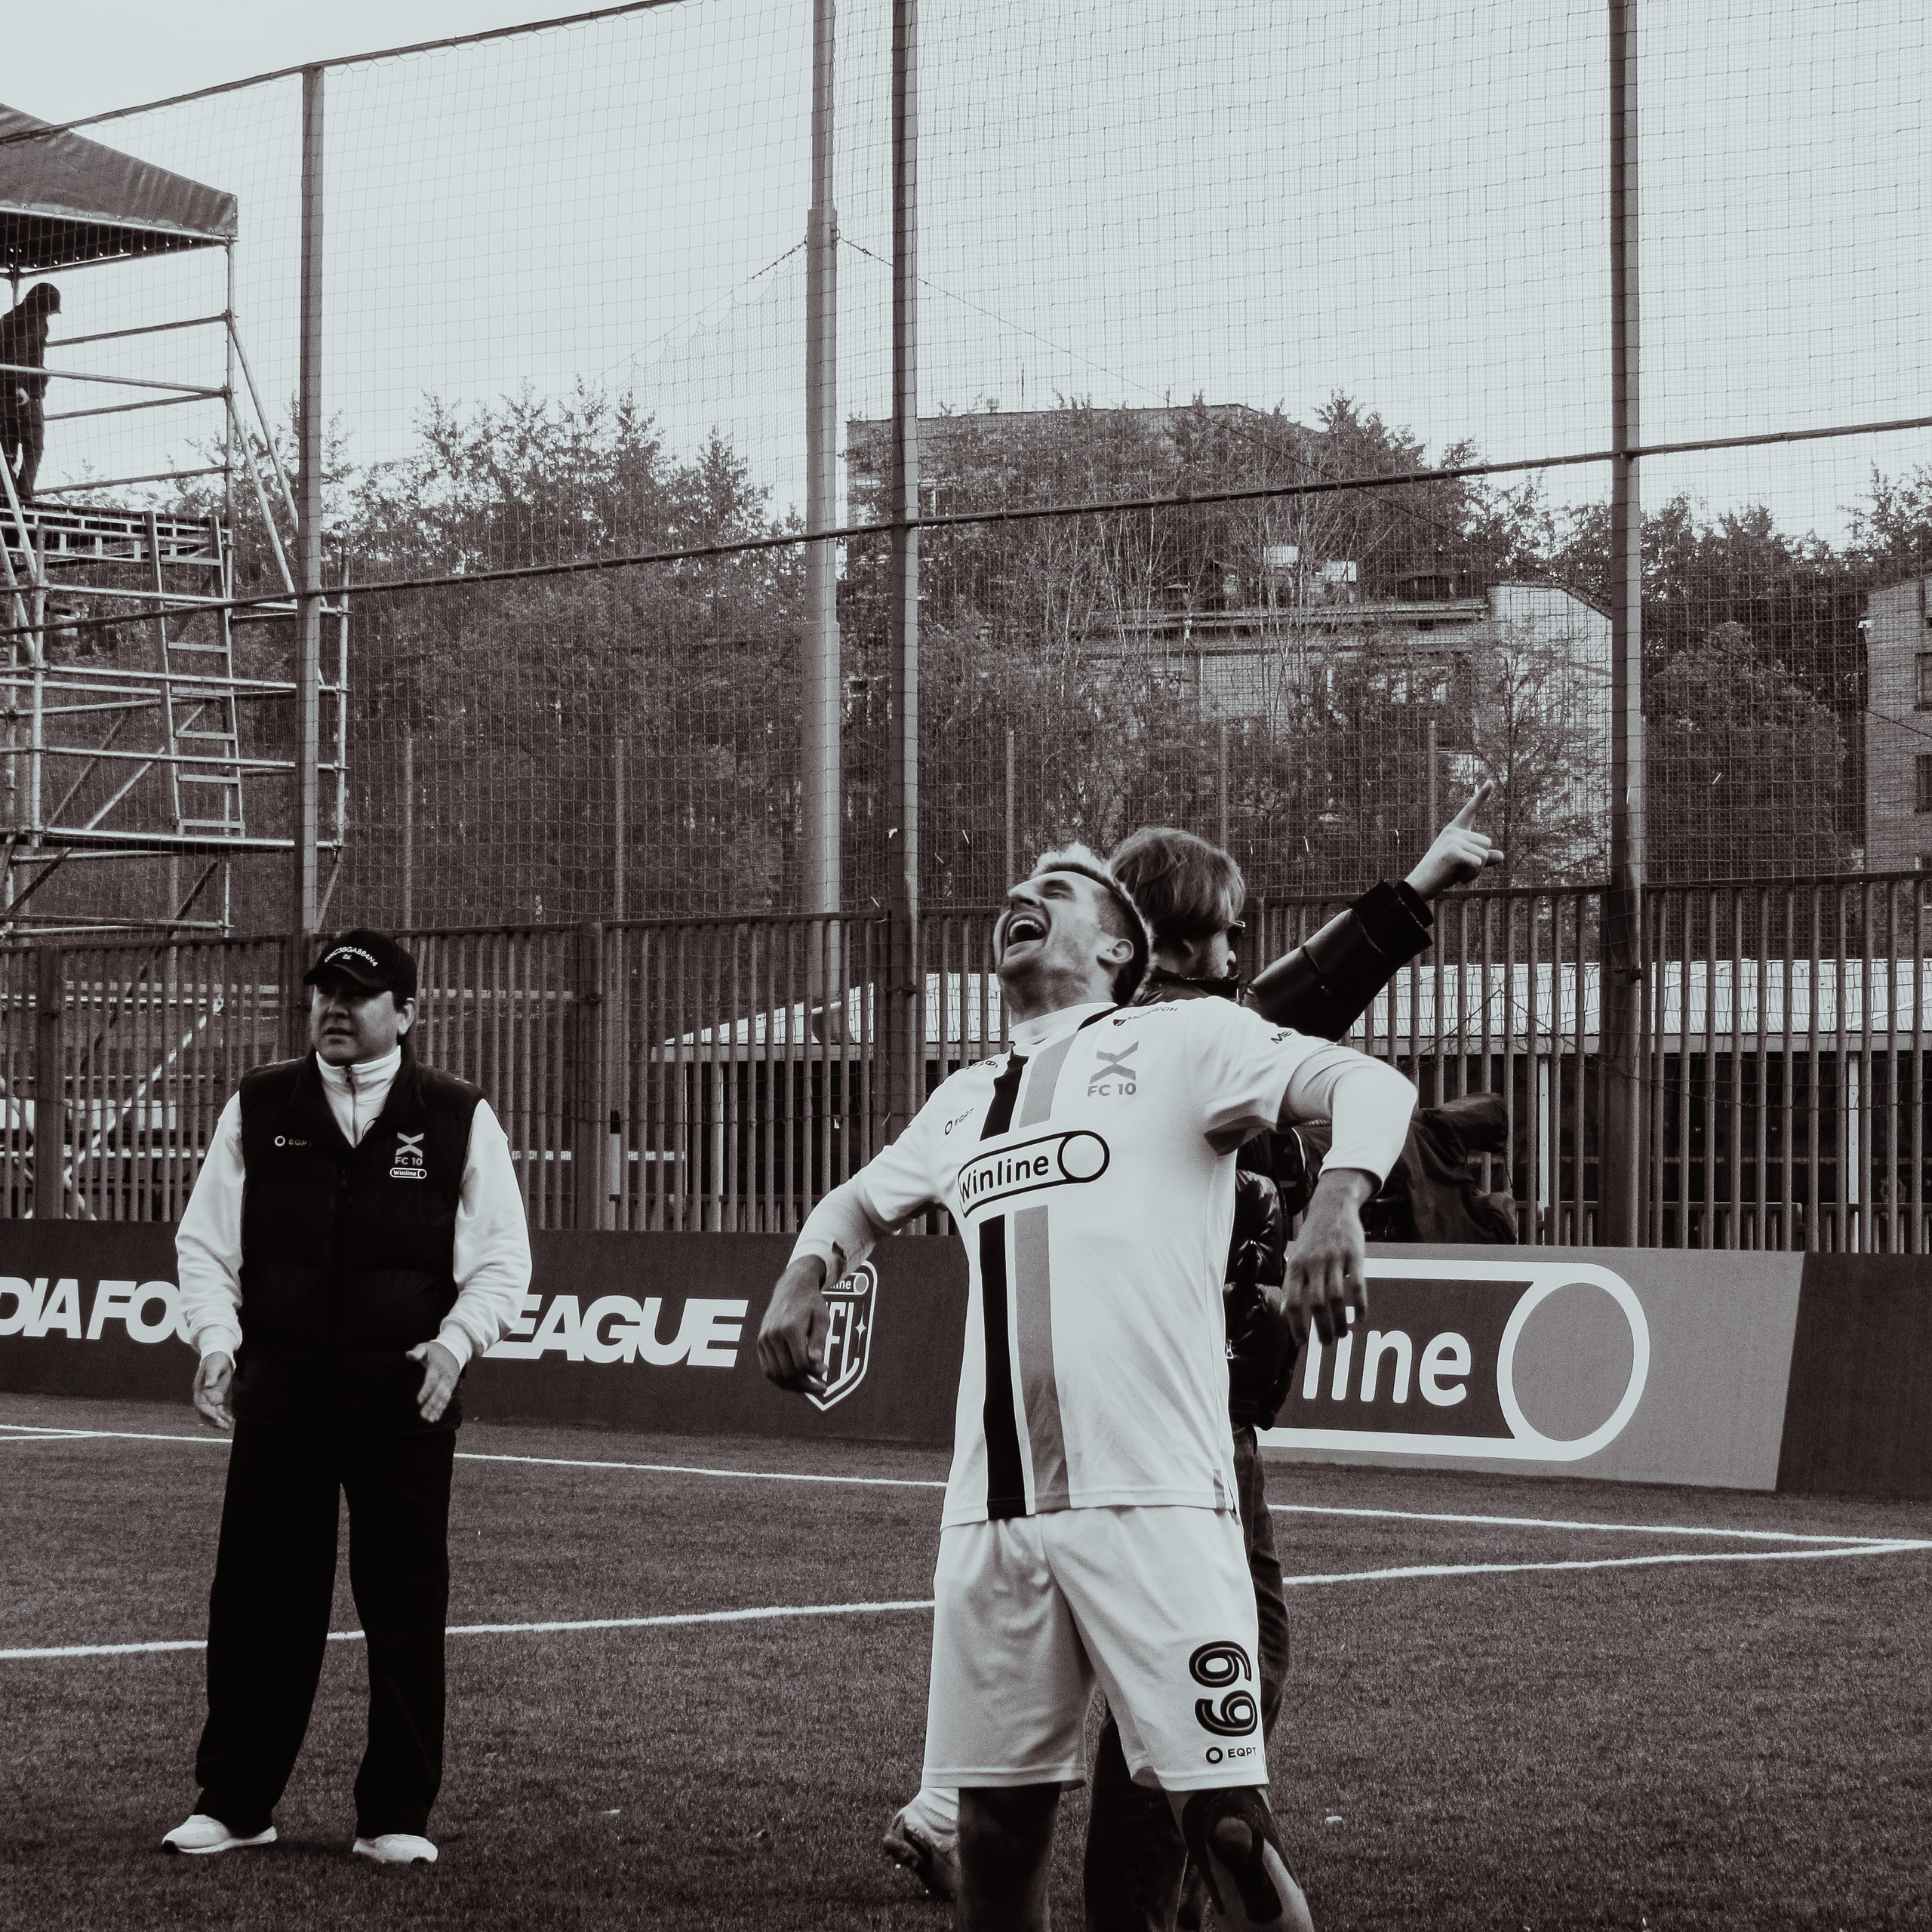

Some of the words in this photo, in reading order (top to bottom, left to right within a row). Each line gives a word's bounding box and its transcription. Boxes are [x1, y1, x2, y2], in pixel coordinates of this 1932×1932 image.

[1088, 1084, 1112, 1097] FC
[1117, 1082, 1137, 1096] 10
[395, 1156, 409, 1164] FC
[411, 1157, 423, 1166] 10
[959, 1155, 1049, 1204] Winline
[86, 1280, 191, 1344] FO
[481, 1294, 749, 1367] EAGUE
[822, 1302, 860, 1397] FL
[1303, 1306, 1472, 1406] line
[1227, 1746, 1257, 1758] EQPT
